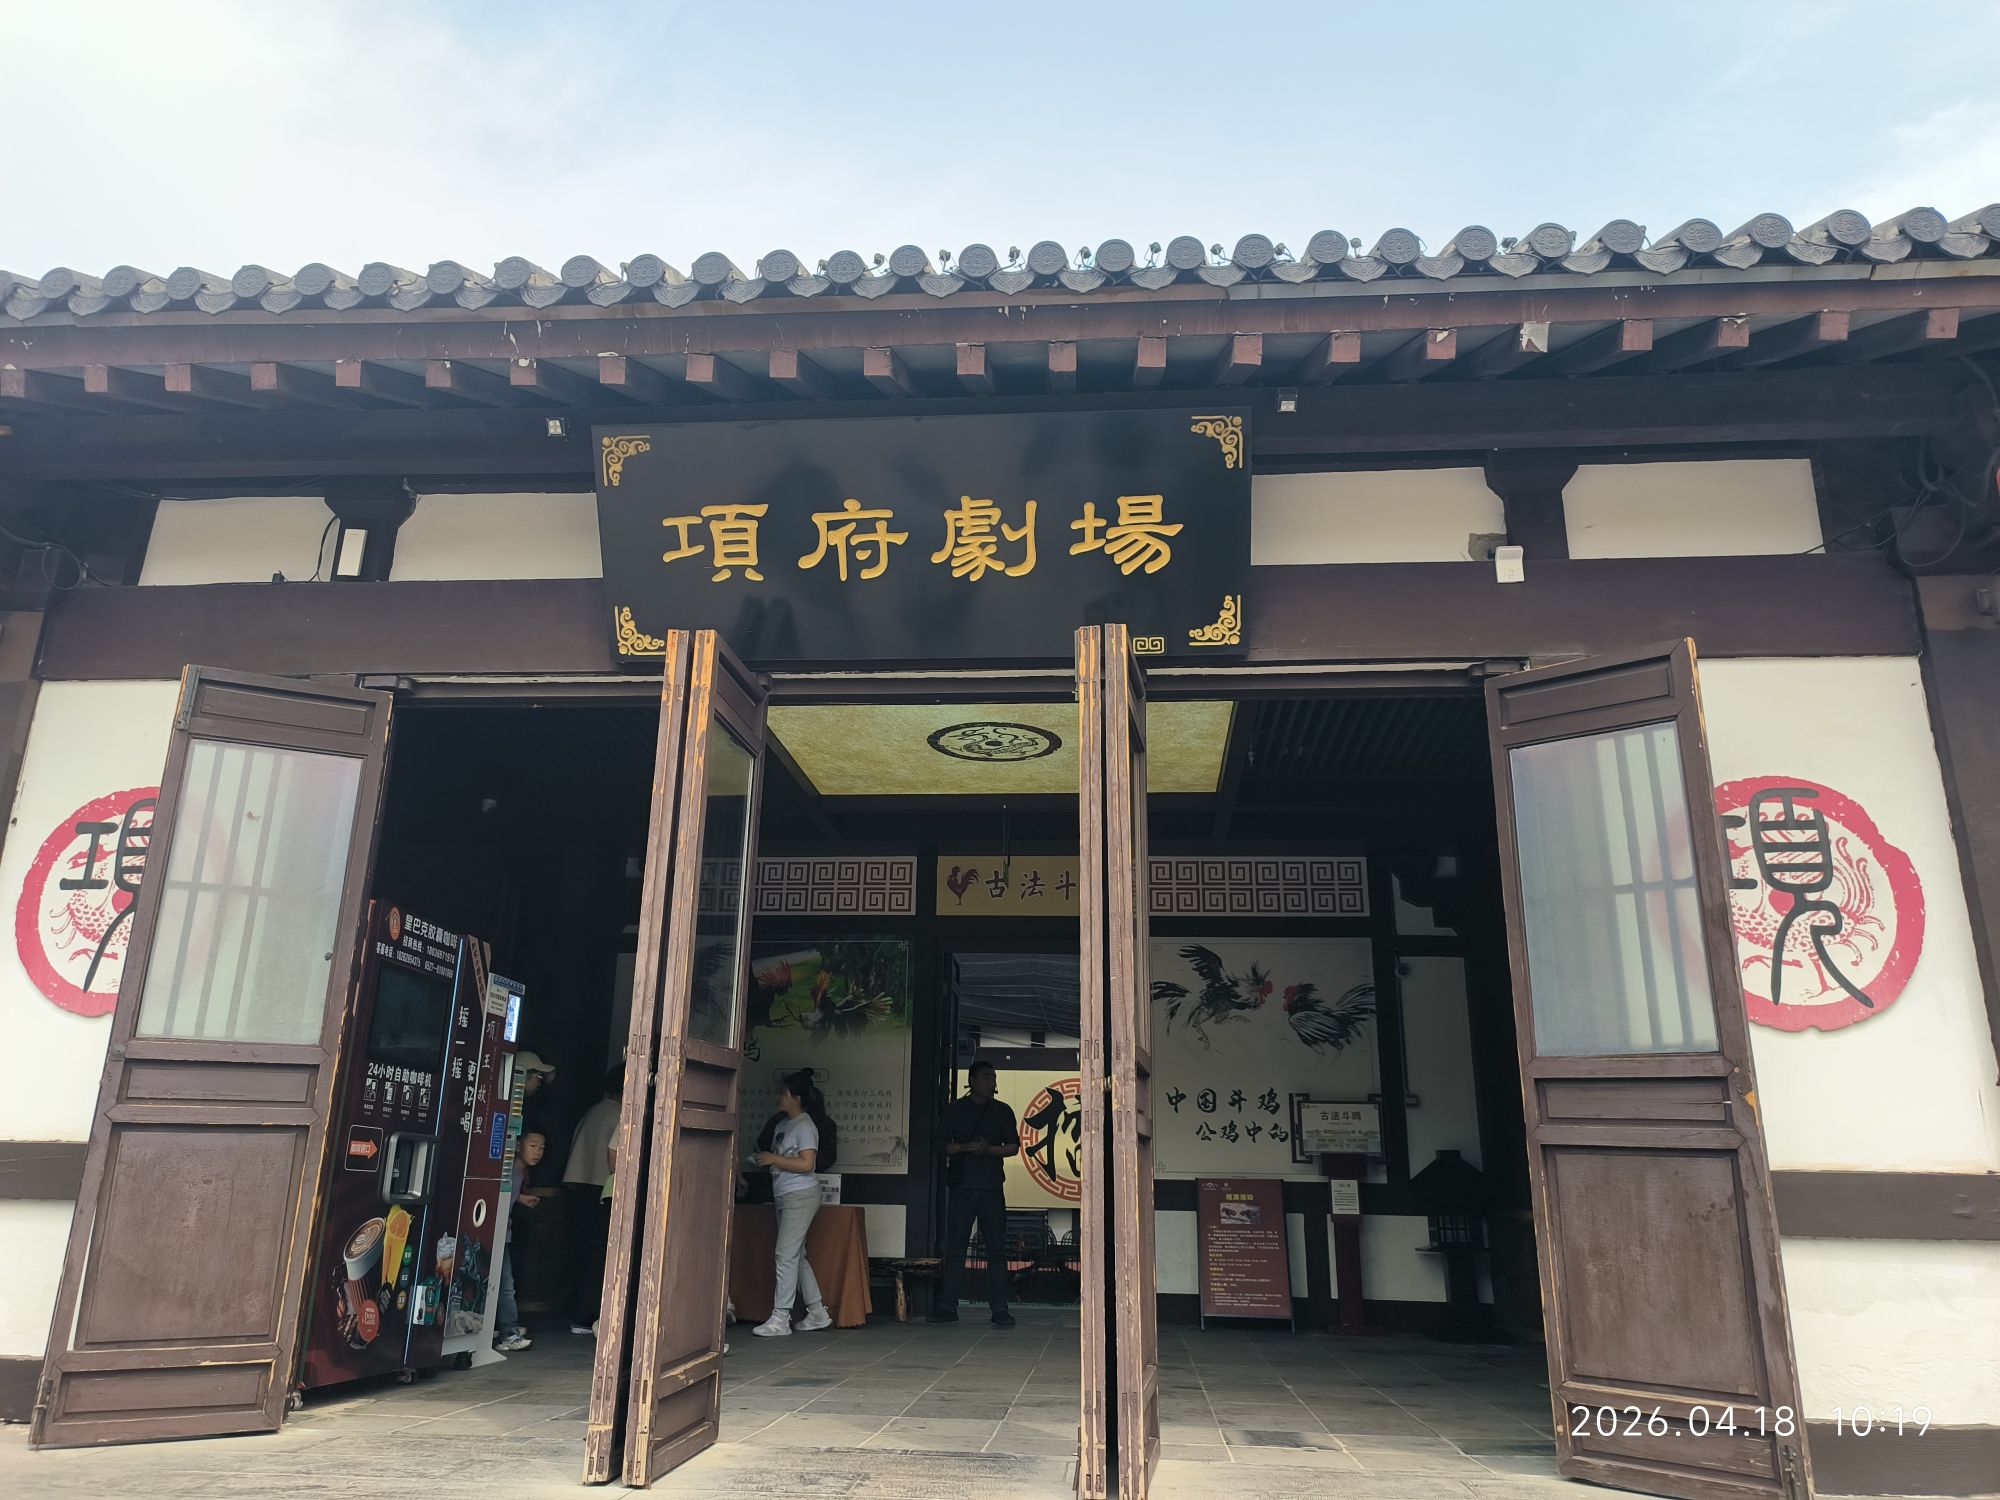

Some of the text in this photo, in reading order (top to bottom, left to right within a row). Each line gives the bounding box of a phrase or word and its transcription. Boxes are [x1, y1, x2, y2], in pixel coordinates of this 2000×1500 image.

[662, 494, 1185, 583] 項府劇場
[367, 1062, 432, 1088] 24小时自助咖啡机
[1319, 1110, 1362, 1122] 古法斗鸡
